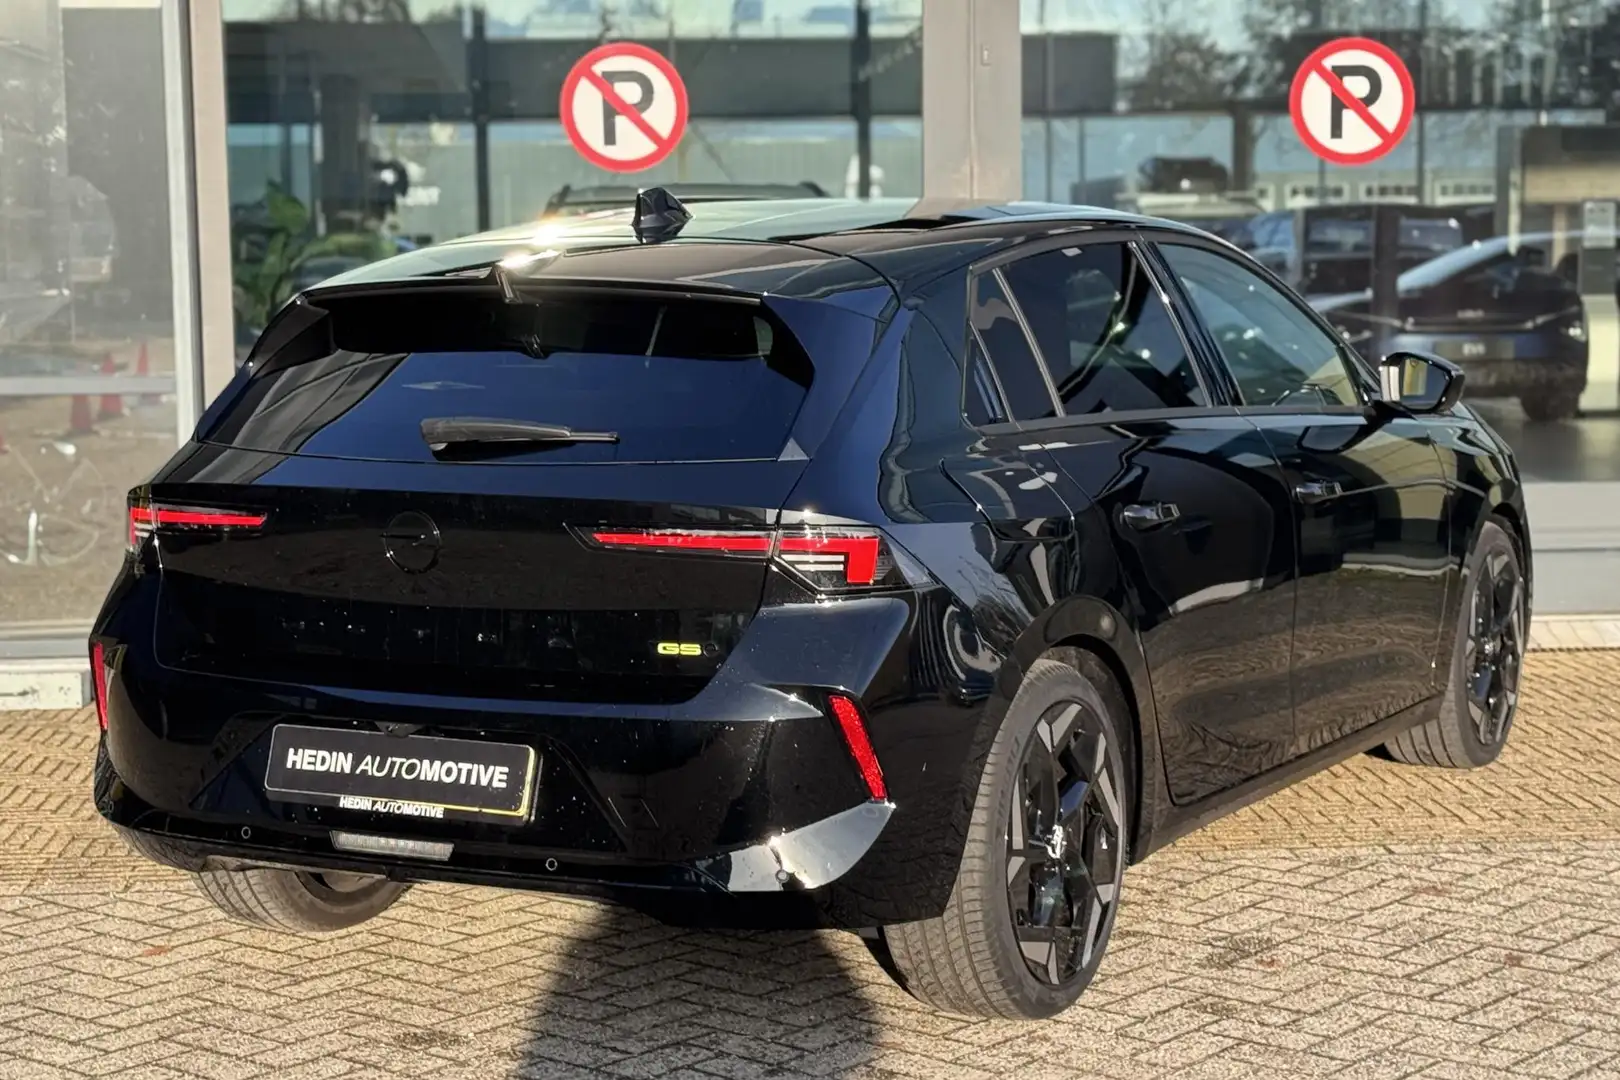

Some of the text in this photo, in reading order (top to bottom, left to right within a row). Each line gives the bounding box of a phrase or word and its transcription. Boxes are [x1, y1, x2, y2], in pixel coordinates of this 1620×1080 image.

[601, 70, 654, 146] P
[1331, 64, 1382, 139] P
[657, 642, 702, 656] GS
[286, 747, 509, 788] HEDIN AUTOMOTIVE
[339, 795, 445, 819] HEDIN AUTOMOTIVE
